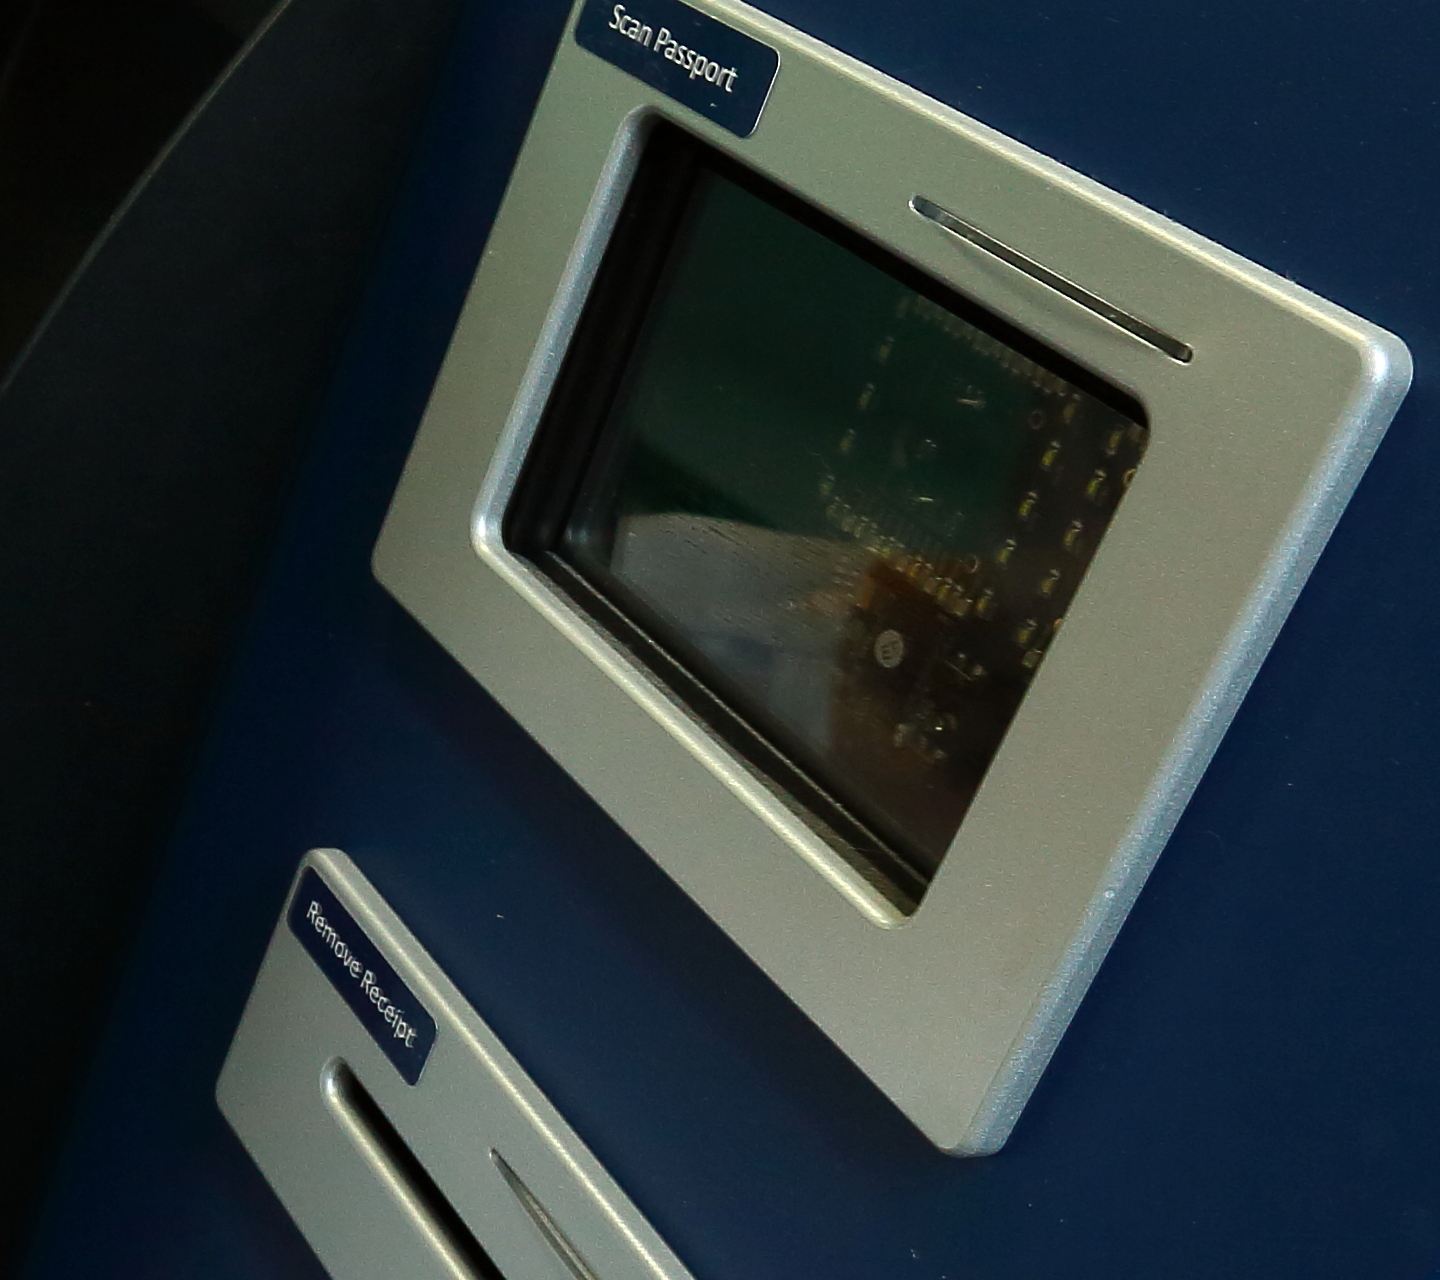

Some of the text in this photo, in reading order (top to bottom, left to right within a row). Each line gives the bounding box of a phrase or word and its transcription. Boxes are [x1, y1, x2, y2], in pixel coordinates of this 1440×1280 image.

[608, 4, 738, 93] Scan Passport
[306, 901, 417, 1048] Remove Receipt
